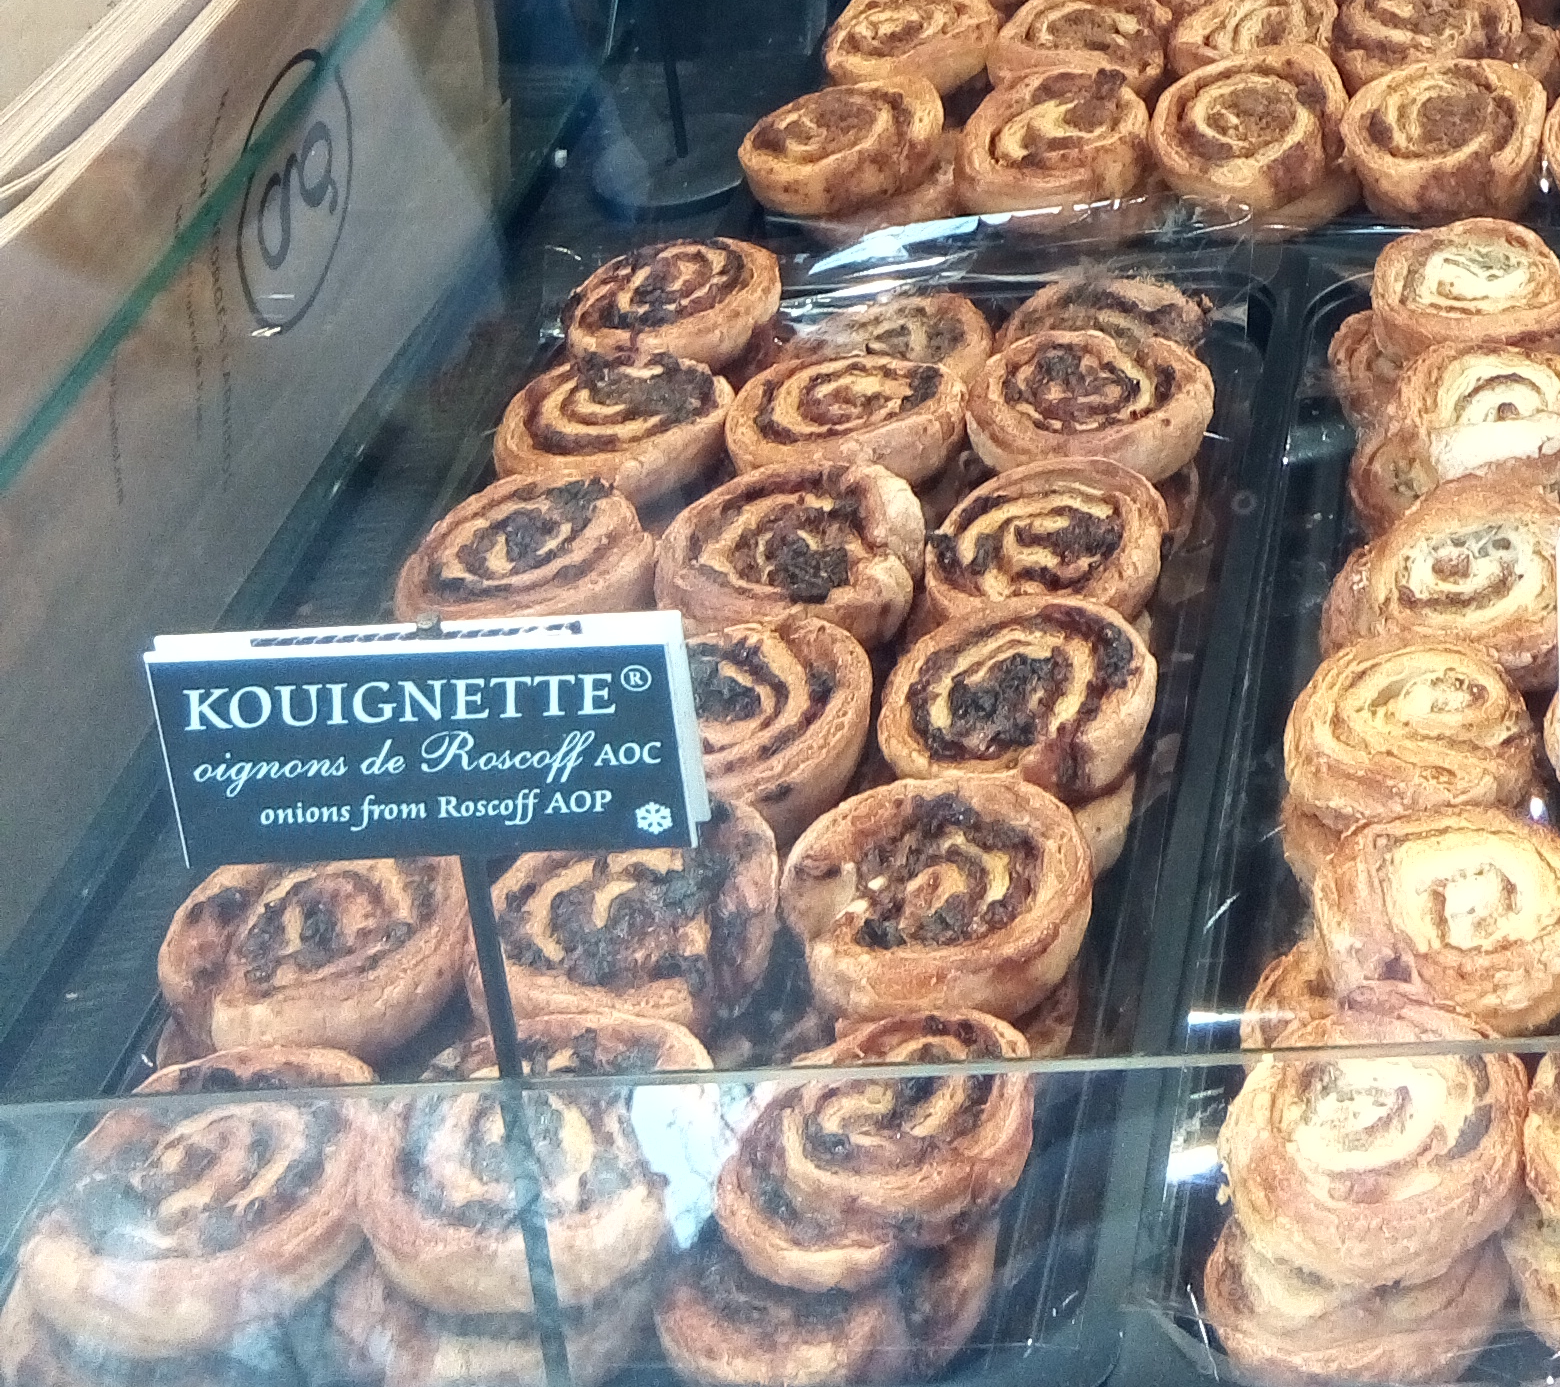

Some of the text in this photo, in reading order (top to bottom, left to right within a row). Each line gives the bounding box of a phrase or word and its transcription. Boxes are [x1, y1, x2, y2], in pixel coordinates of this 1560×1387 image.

[192, 729, 663, 798] oignons de Roscoff AOC
[259, 788, 614, 832] onions from Roscoff AOP
